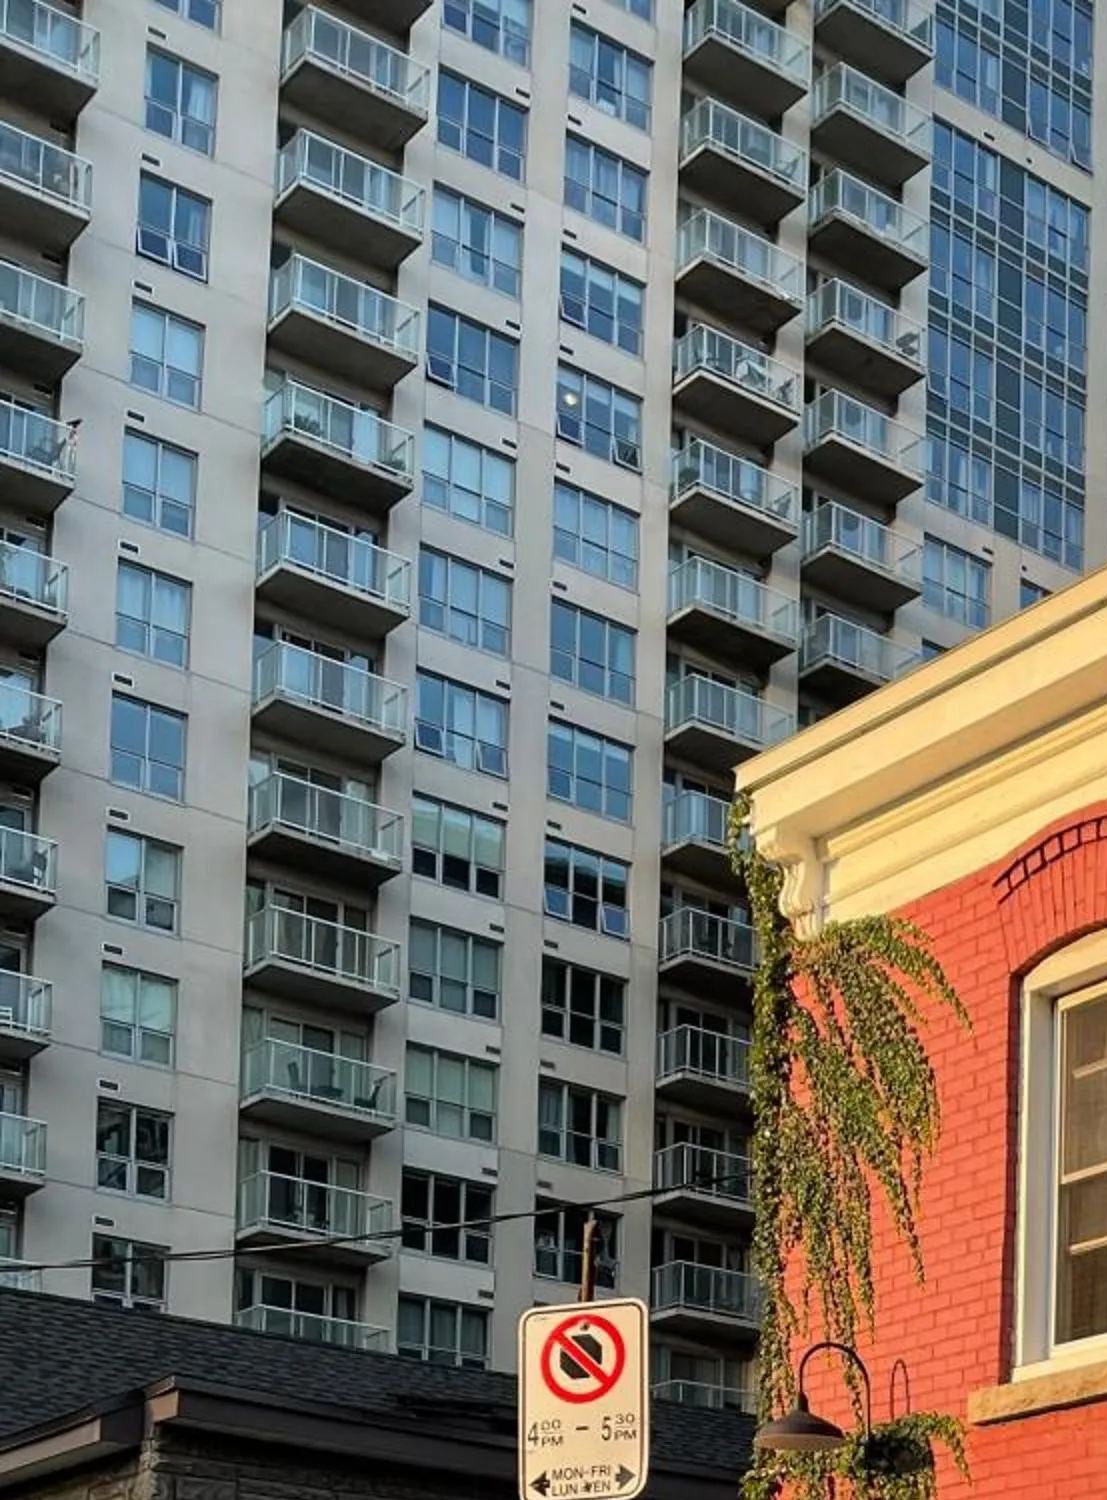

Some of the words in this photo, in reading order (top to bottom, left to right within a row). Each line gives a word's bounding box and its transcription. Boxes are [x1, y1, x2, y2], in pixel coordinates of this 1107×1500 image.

[541, 1435, 563, 1447] PM
[614, 1429, 637, 1440] PM
[552, 1465, 611, 1480] MON-FRI
[552, 1480, 611, 1497] LUNVEN
